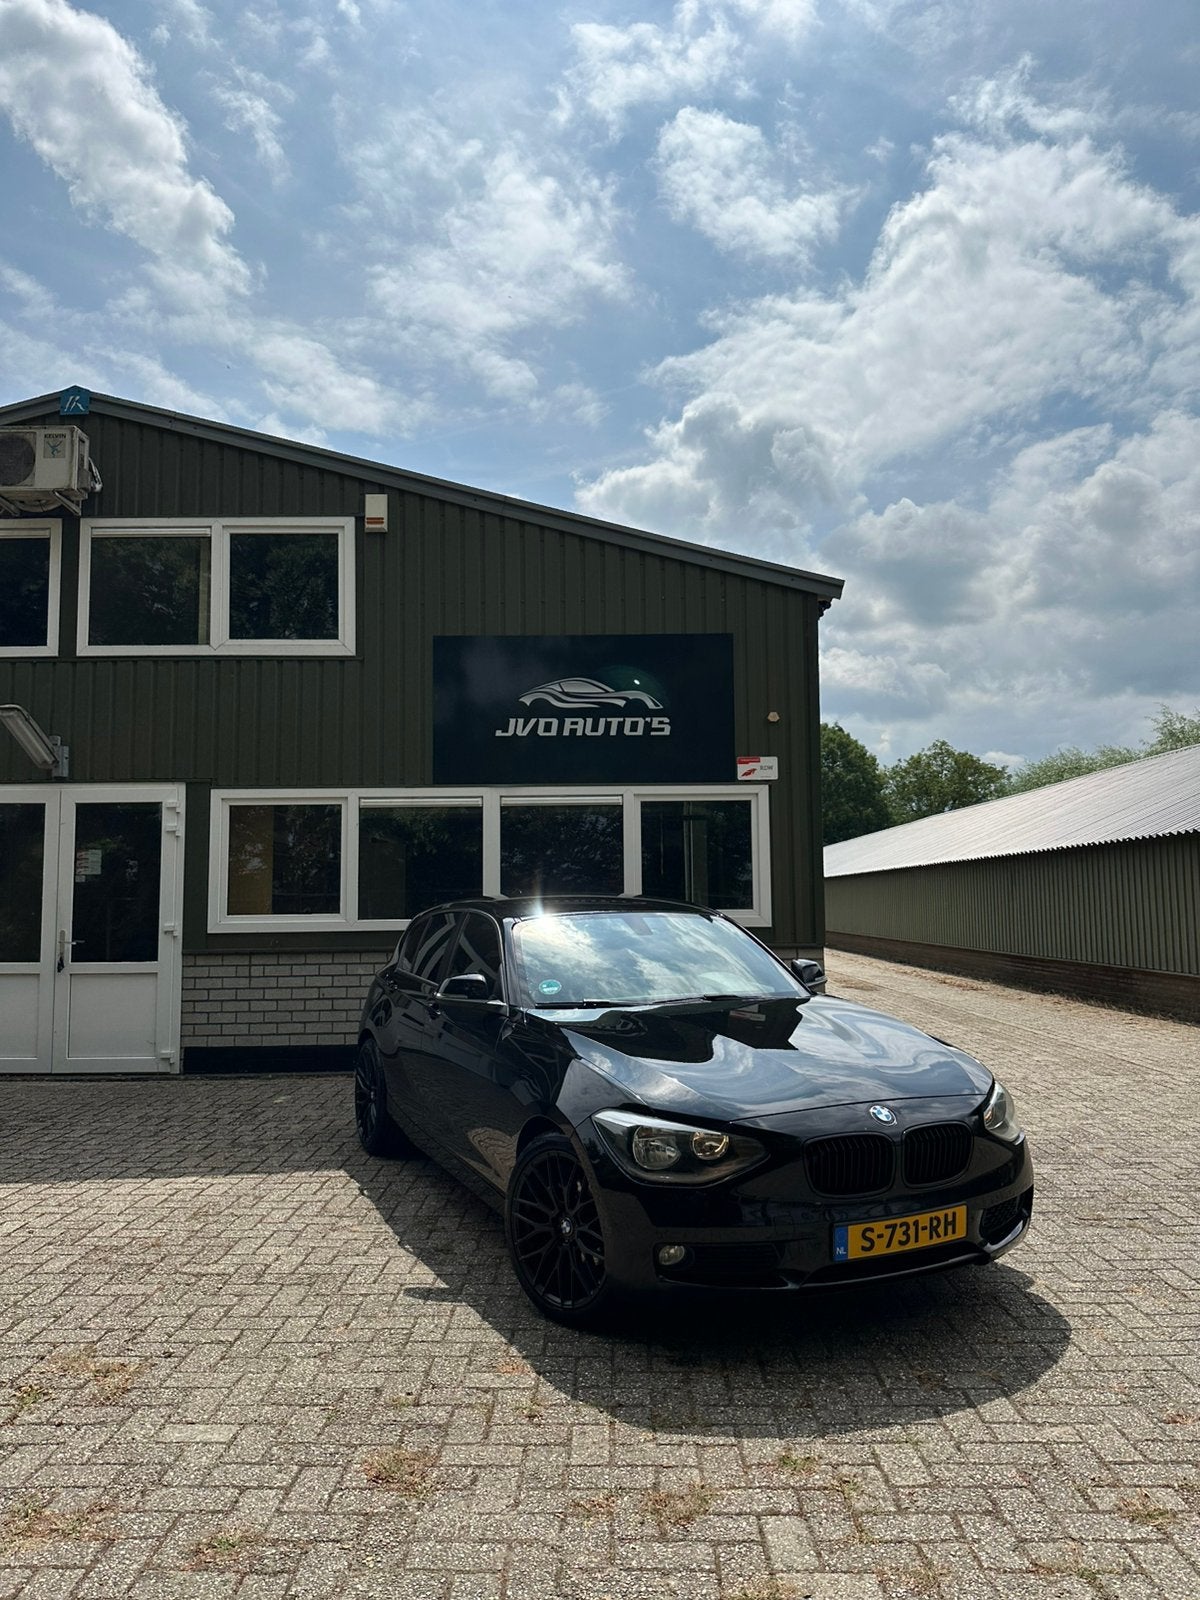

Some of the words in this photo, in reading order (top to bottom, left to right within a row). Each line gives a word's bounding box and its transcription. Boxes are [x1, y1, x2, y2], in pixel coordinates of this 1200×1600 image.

[495, 717, 559, 737] JVO
[562, 716, 672, 736] AUTO'S
[860, 1211, 957, 1252] S-731-RH
[836, 1247, 847, 1255] NL
